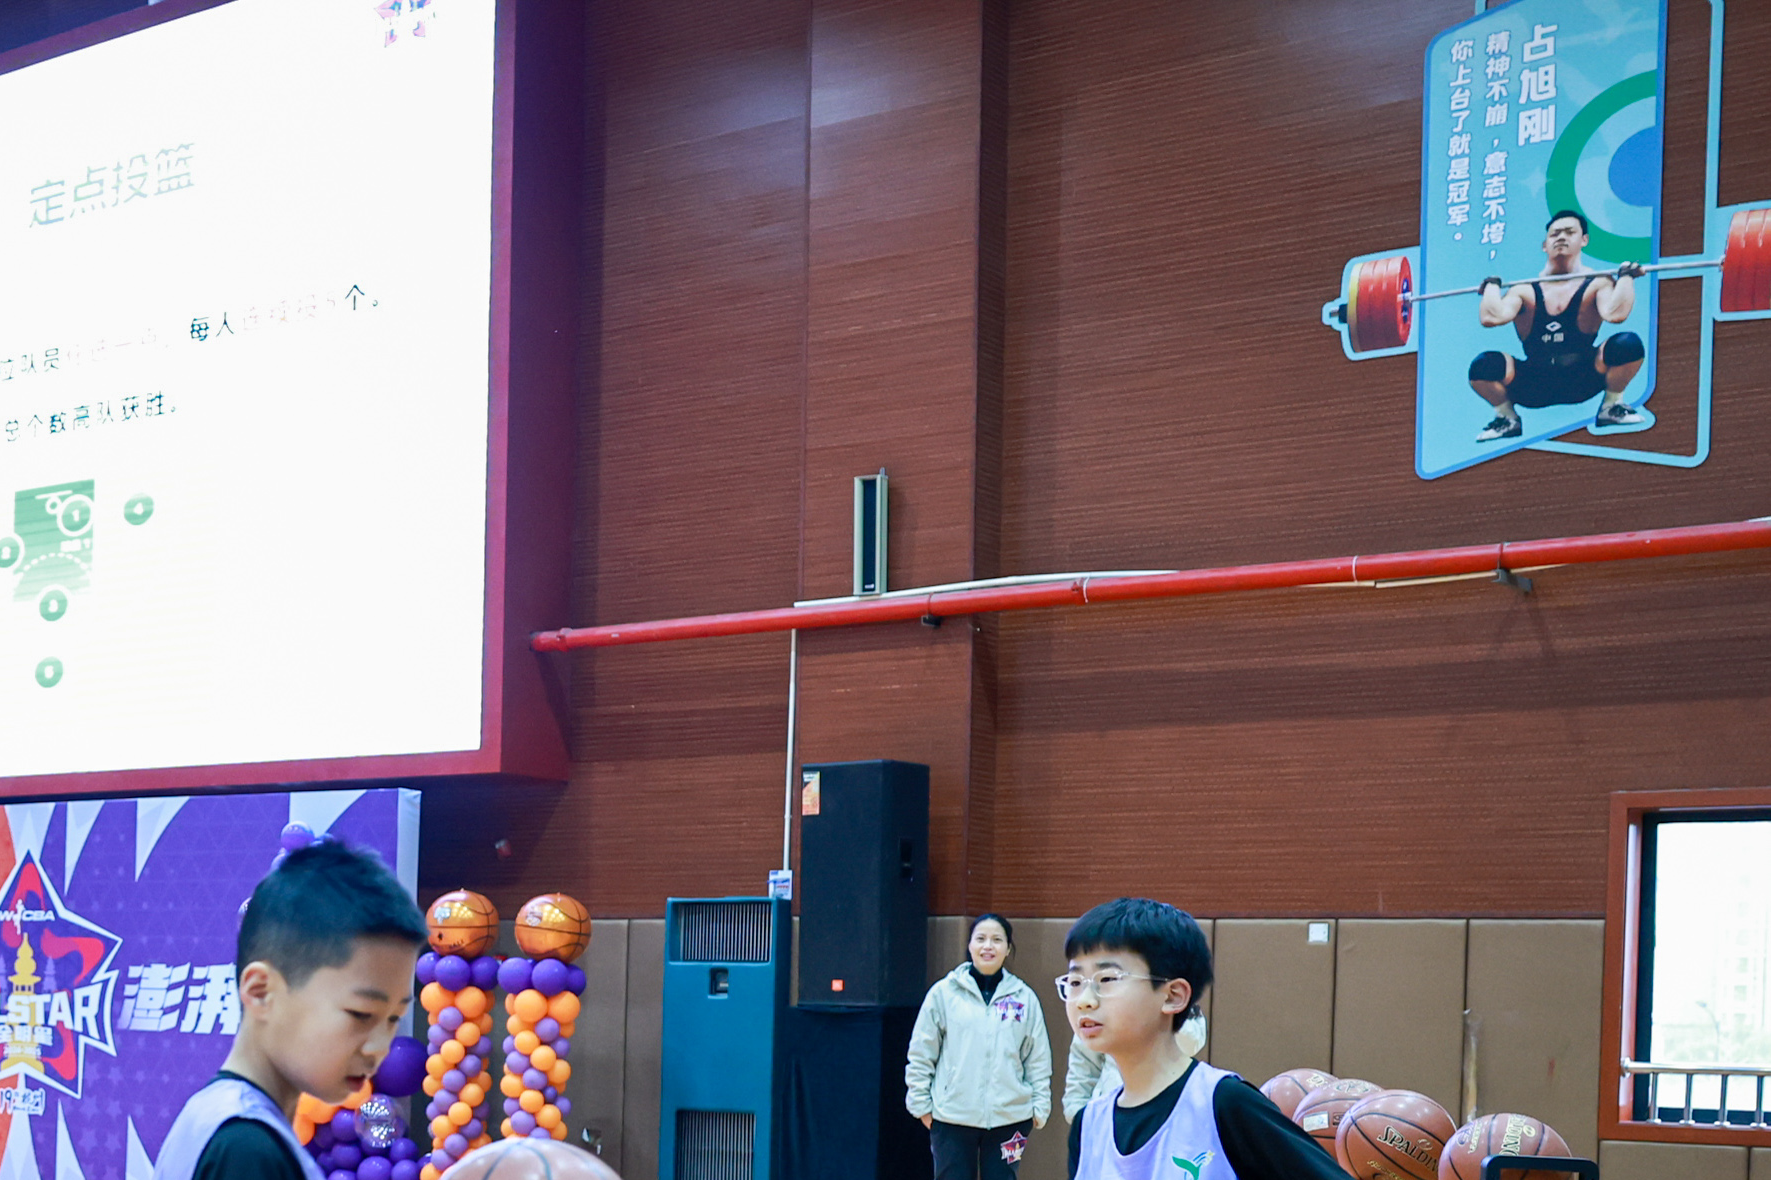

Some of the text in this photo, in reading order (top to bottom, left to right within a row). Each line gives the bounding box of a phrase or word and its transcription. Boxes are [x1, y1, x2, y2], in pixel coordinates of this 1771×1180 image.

[1446, 39, 1474, 241] 你上台了就是冠军。
[1518, 23, 1558, 146] 占旭刚
[29, 142, 196, 229] 定点投篮
